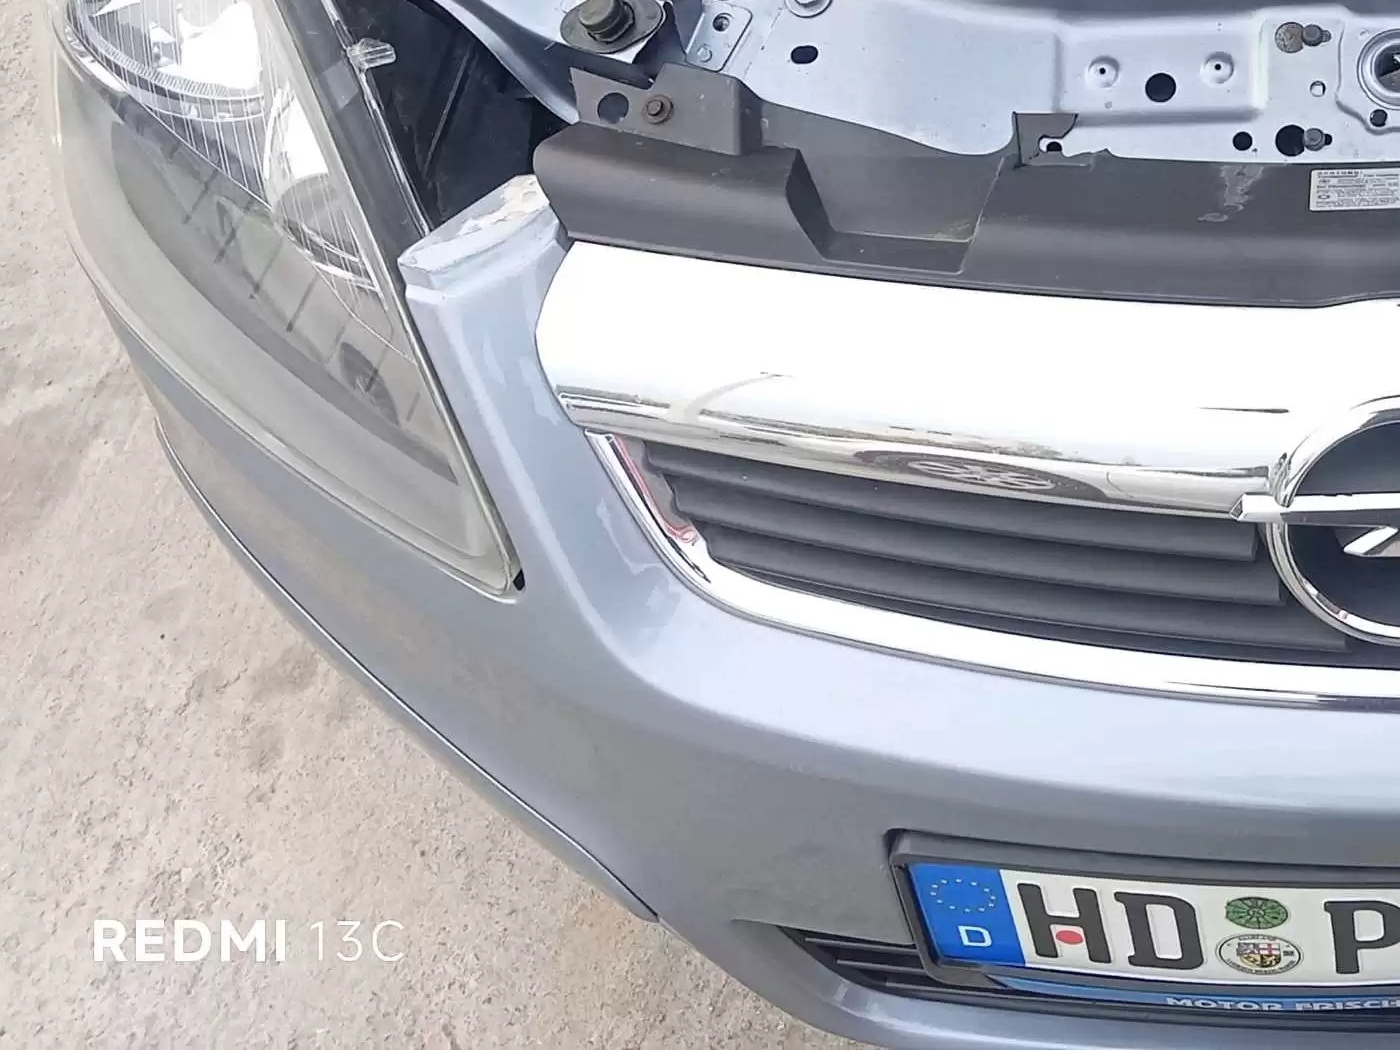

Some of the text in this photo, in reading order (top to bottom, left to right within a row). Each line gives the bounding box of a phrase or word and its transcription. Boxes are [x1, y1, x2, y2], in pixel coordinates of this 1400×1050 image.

[957, 925, 993, 948] D
[1017, 882, 1204, 970] HD
[1165, 996, 1285, 1011] MOTOR
